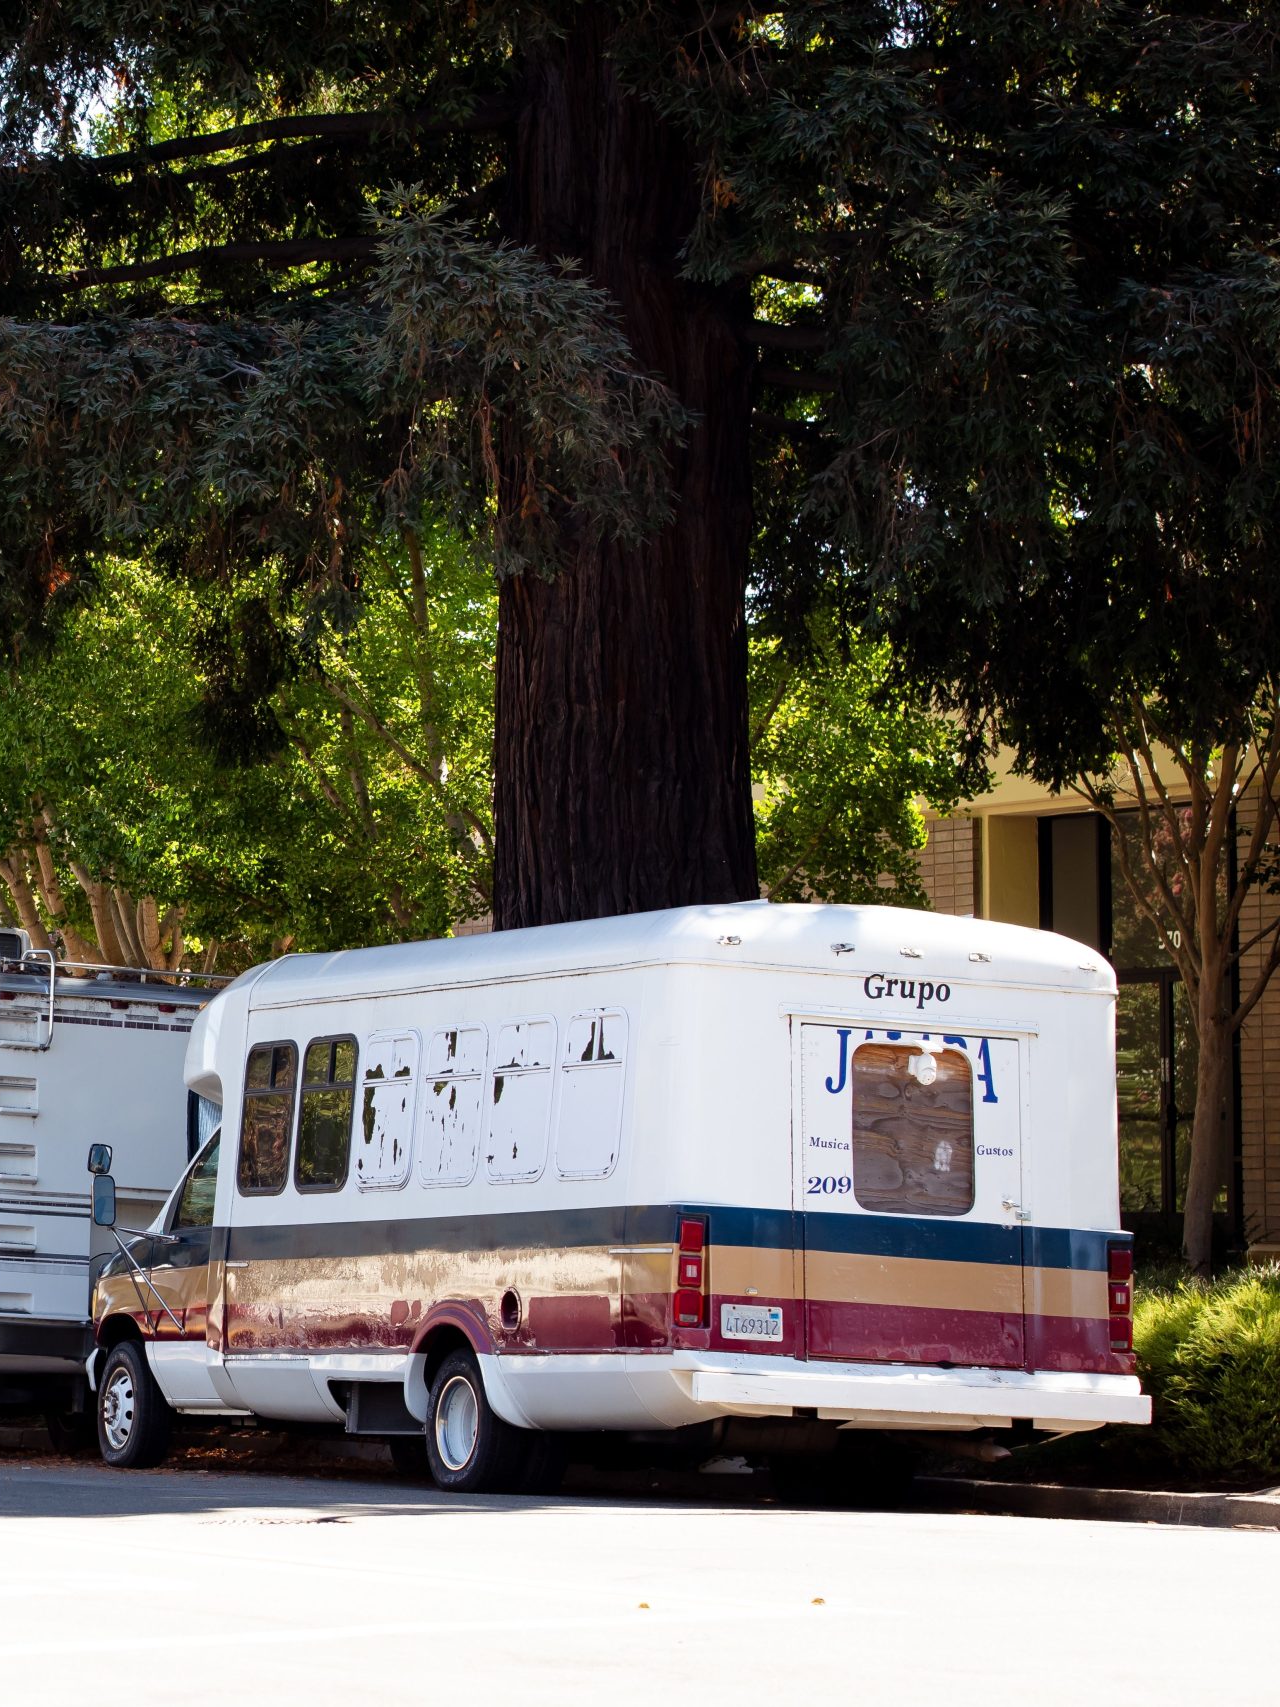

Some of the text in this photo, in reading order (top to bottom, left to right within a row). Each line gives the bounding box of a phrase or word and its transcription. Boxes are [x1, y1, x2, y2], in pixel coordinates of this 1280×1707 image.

[864, 973, 951, 1010] Grupo
[809, 1136, 1014, 1157] Musica Gustos
[807, 1176, 852, 1194] 209
[726, 1317, 779, 1336] 4T69312
